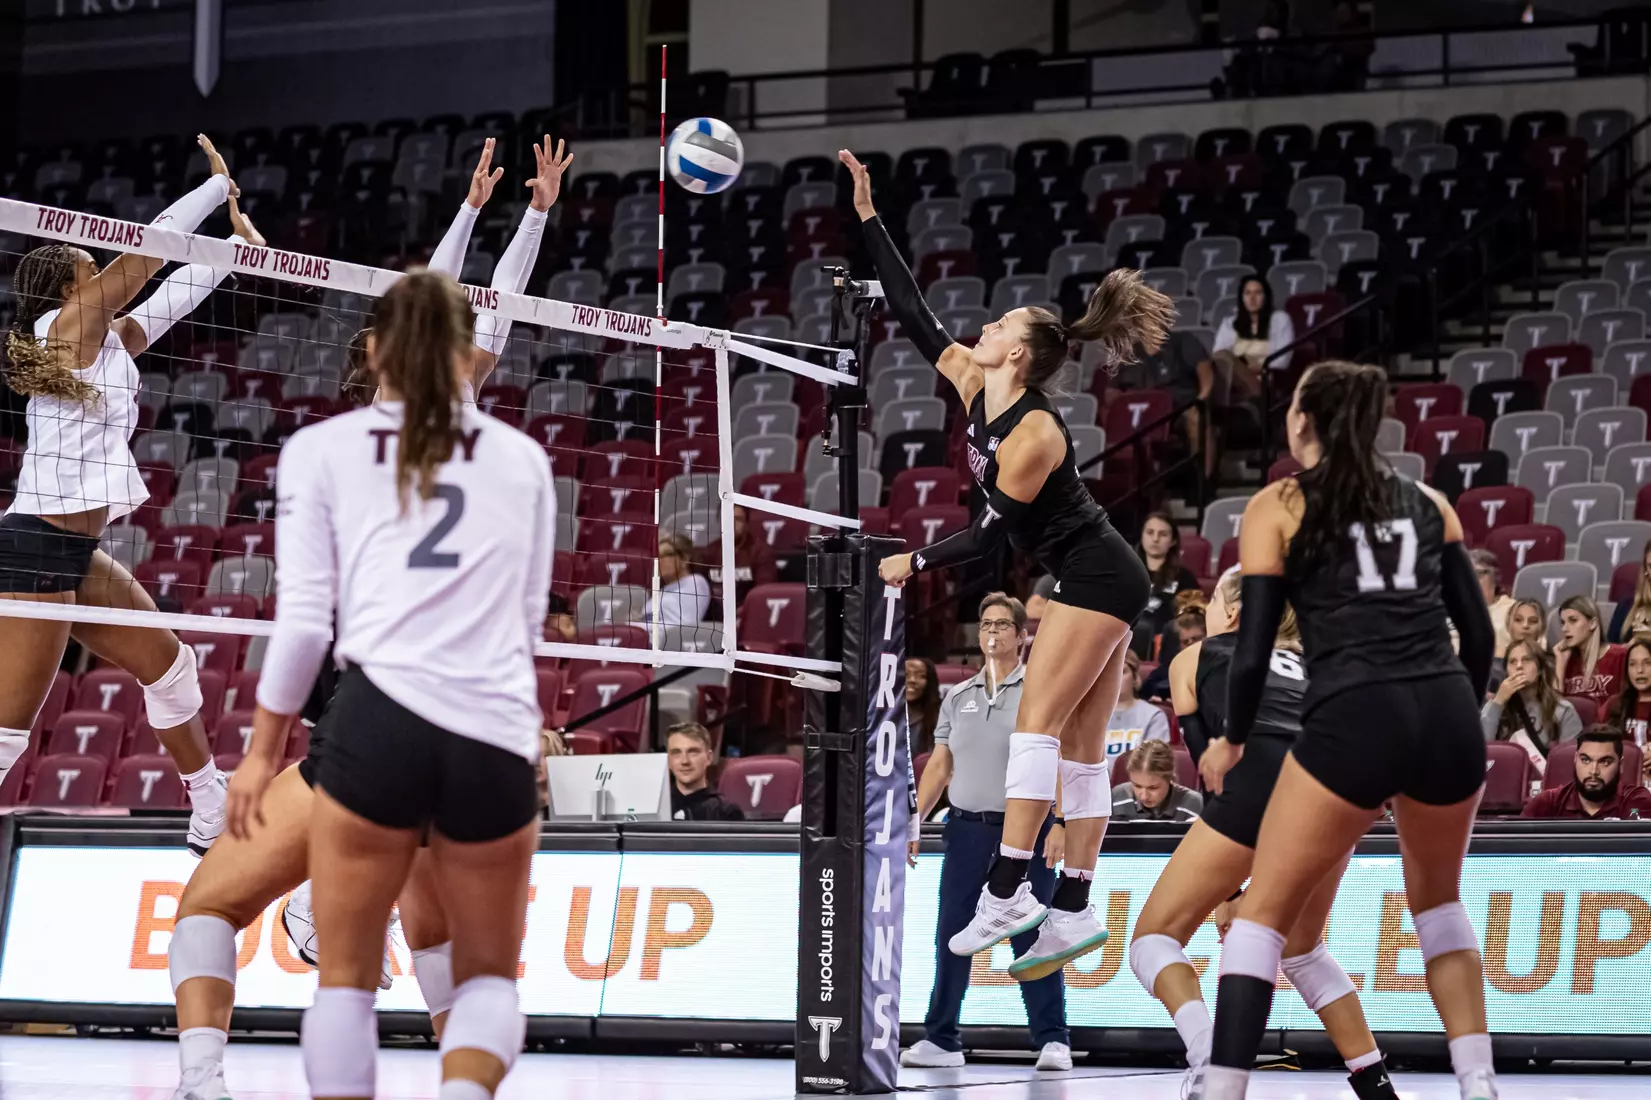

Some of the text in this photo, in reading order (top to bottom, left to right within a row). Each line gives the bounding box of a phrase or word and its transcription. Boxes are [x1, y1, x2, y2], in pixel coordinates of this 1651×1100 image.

[37, 207, 144, 247] TROY TROJANS
[233, 244, 330, 280] TROY TROJANS
[464, 285, 499, 310] JANS
[572, 305, 652, 336] TROY TROJANS
[368, 428, 482, 464] TY
[408, 483, 465, 568] 2
[1348, 518, 1419, 593] 17
[871, 585, 902, 1050] TROJANS
[819, 868, 836, 927] sports
[563, 886, 714, 981] UP
[1483, 891, 1651, 995] UP
